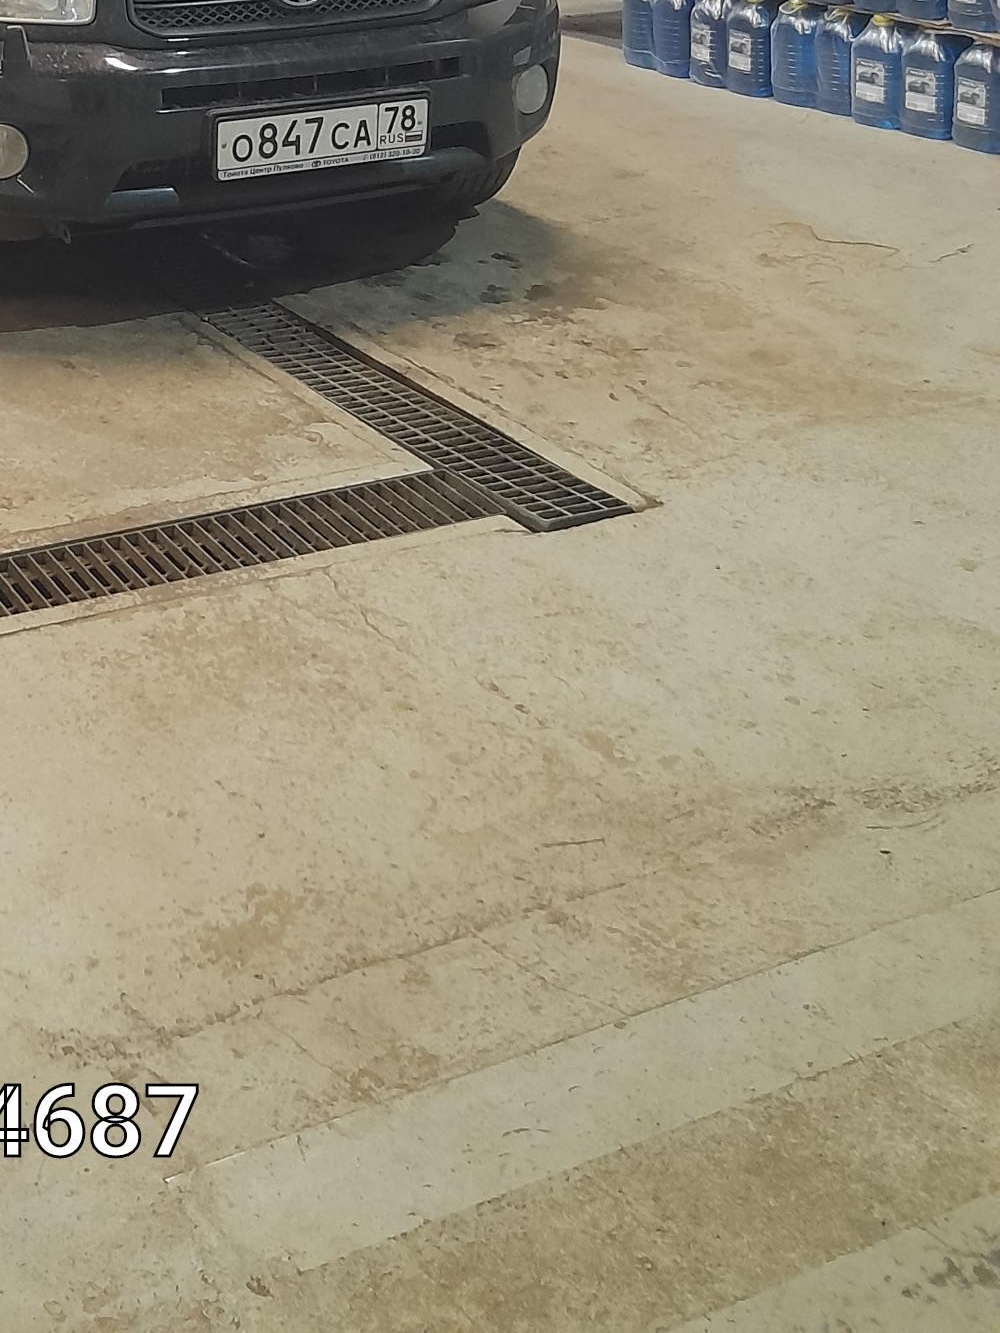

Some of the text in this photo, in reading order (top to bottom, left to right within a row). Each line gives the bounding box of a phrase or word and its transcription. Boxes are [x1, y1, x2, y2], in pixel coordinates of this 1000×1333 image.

[384, 105, 416, 134] 78
[379, 132, 404, 145] RUS
[323, 157, 349, 167] TOYOTA
